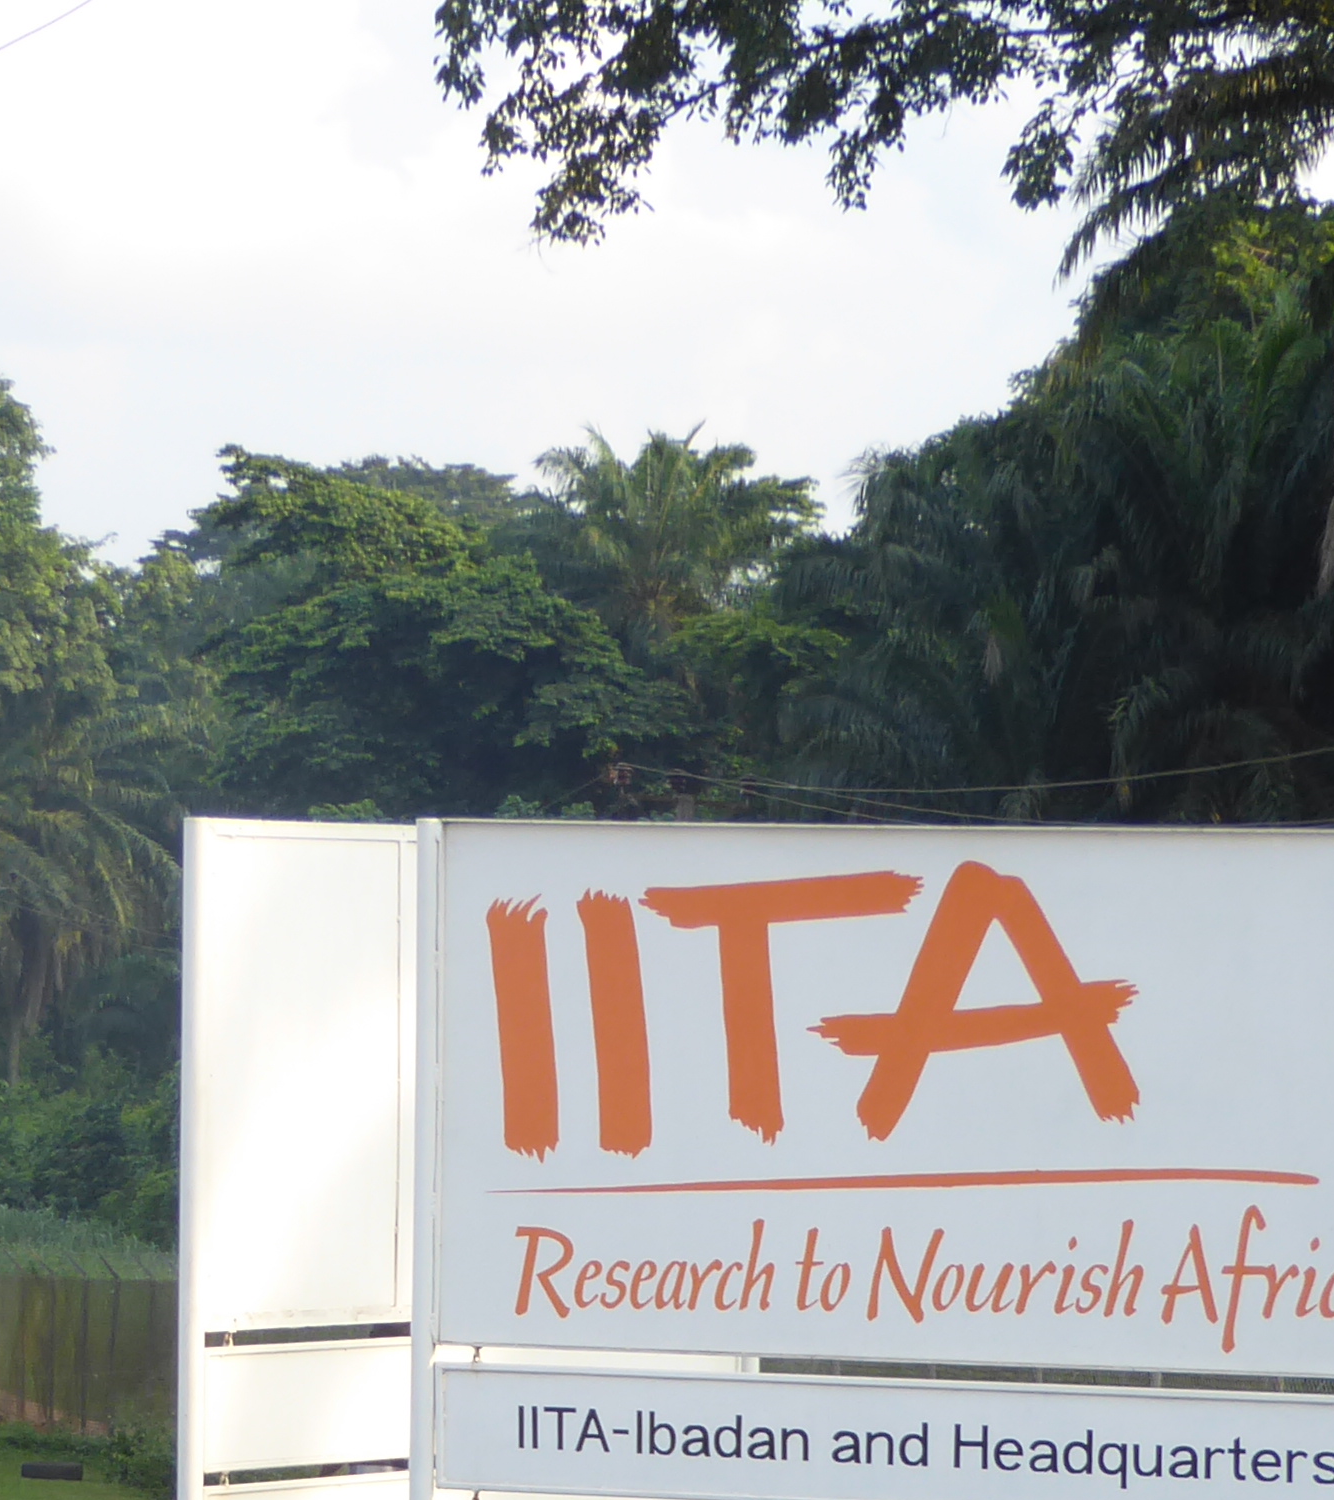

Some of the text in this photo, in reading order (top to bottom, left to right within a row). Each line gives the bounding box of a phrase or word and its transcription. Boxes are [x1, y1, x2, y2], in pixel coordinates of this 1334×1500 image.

[487, 862, 1140, 1161] IITA
[516, 1221, 775, 1319] Research
[797, 1231, 851, 1312] to
[867, 1221, 1144, 1324] Nourish
[518, 1405, 810, 1462] IITA-Ibadan
[832, 1422, 929, 1468] and
